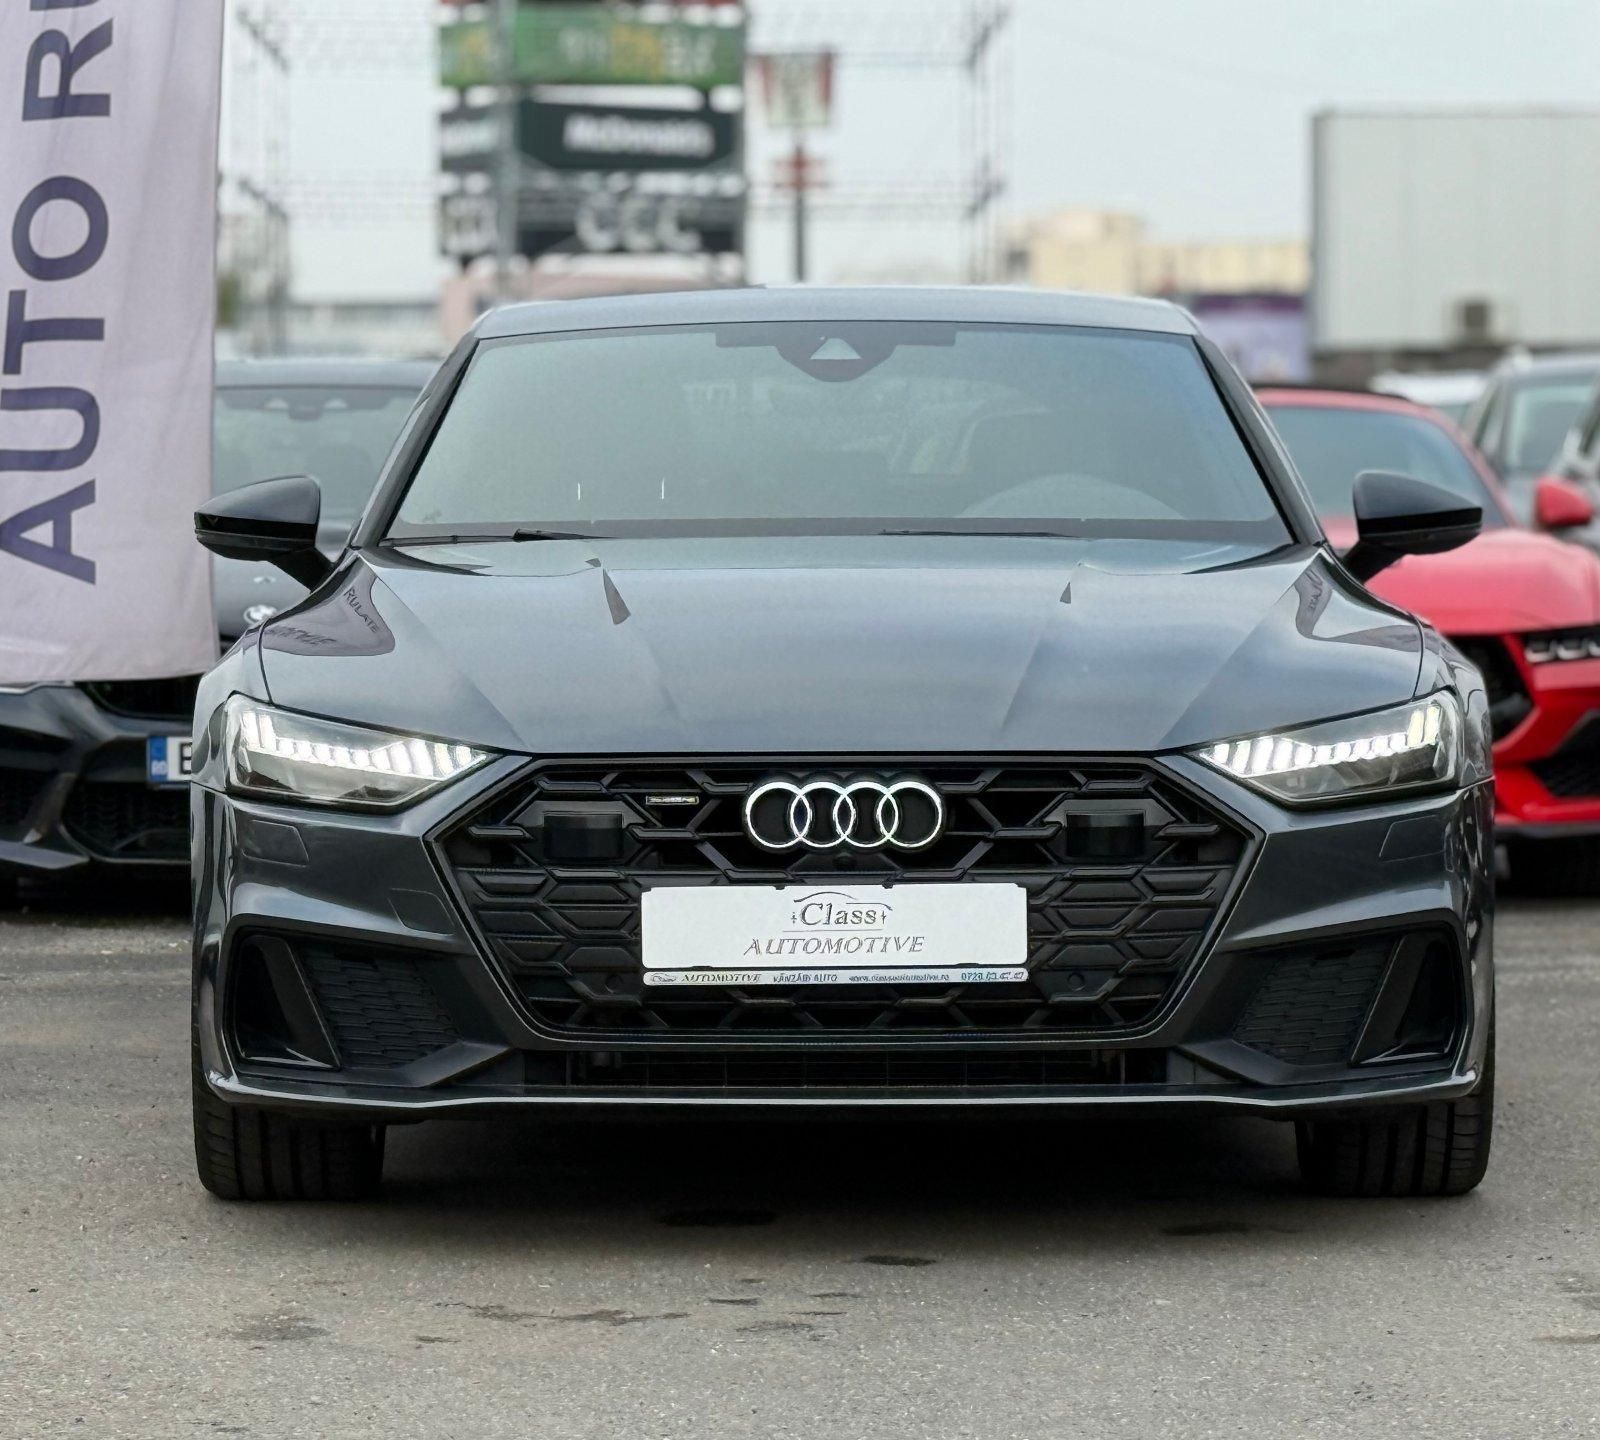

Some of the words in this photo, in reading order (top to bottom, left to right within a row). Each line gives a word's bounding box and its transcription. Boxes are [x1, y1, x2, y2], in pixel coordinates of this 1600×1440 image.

[21, 0, 114, 121] R
[0, 175, 109, 586] AUTO
[743, 936, 925, 956] AUTOMOTIVE
[801, 902, 877, 926] Class
